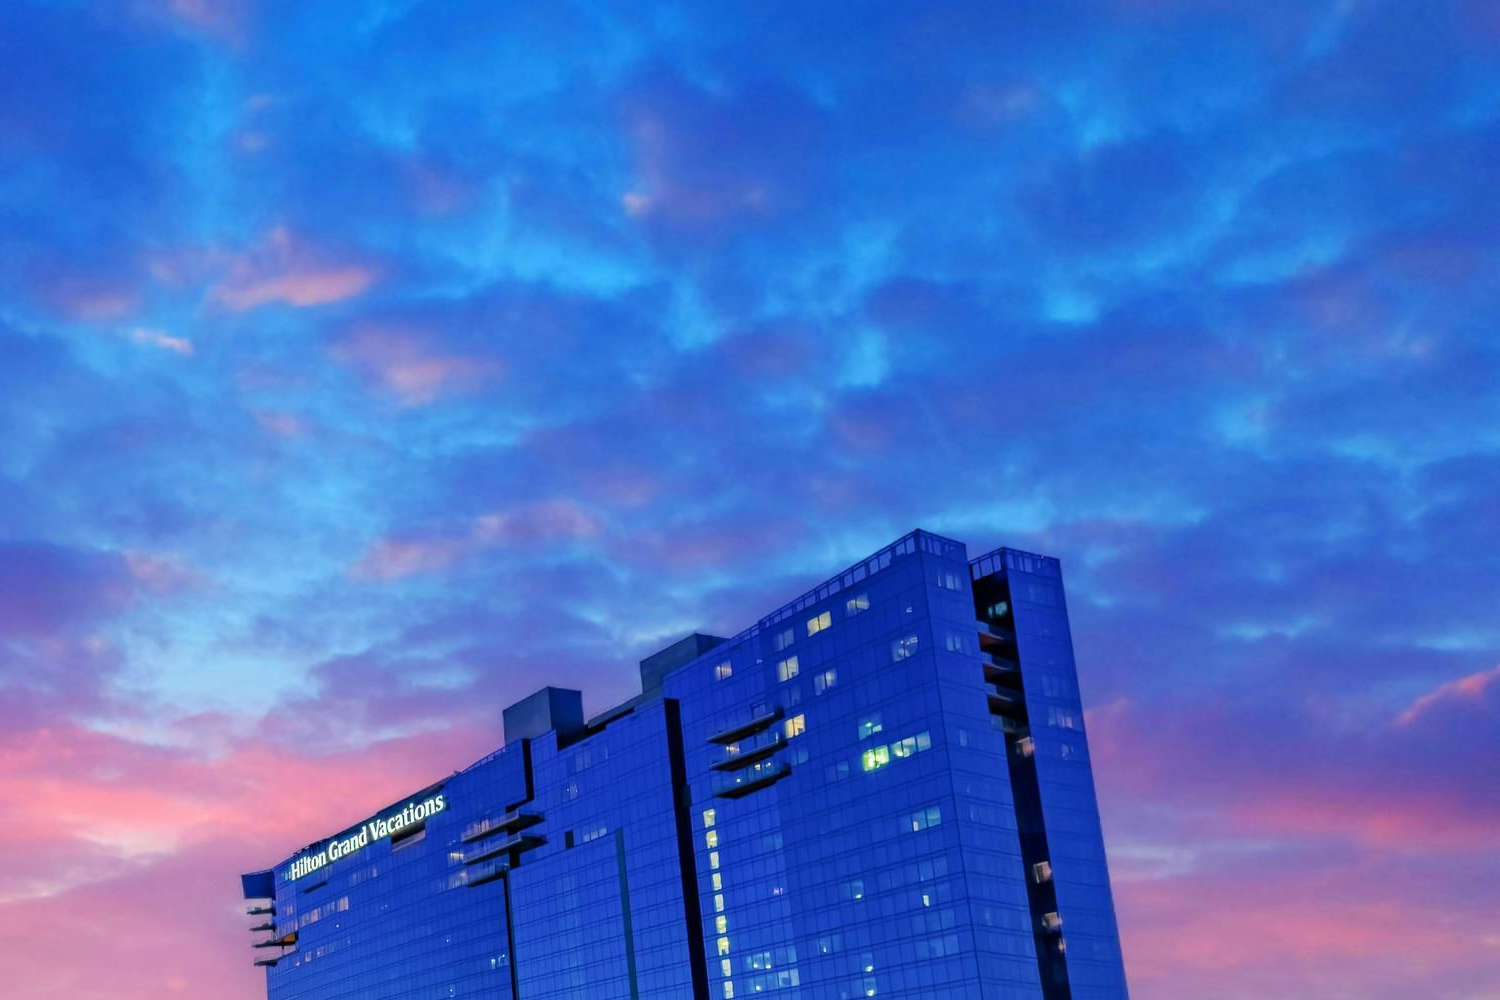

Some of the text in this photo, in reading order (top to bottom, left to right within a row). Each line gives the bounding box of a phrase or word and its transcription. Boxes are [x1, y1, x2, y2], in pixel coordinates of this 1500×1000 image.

[290, 794, 444, 881] Hilton Grand Vacations
